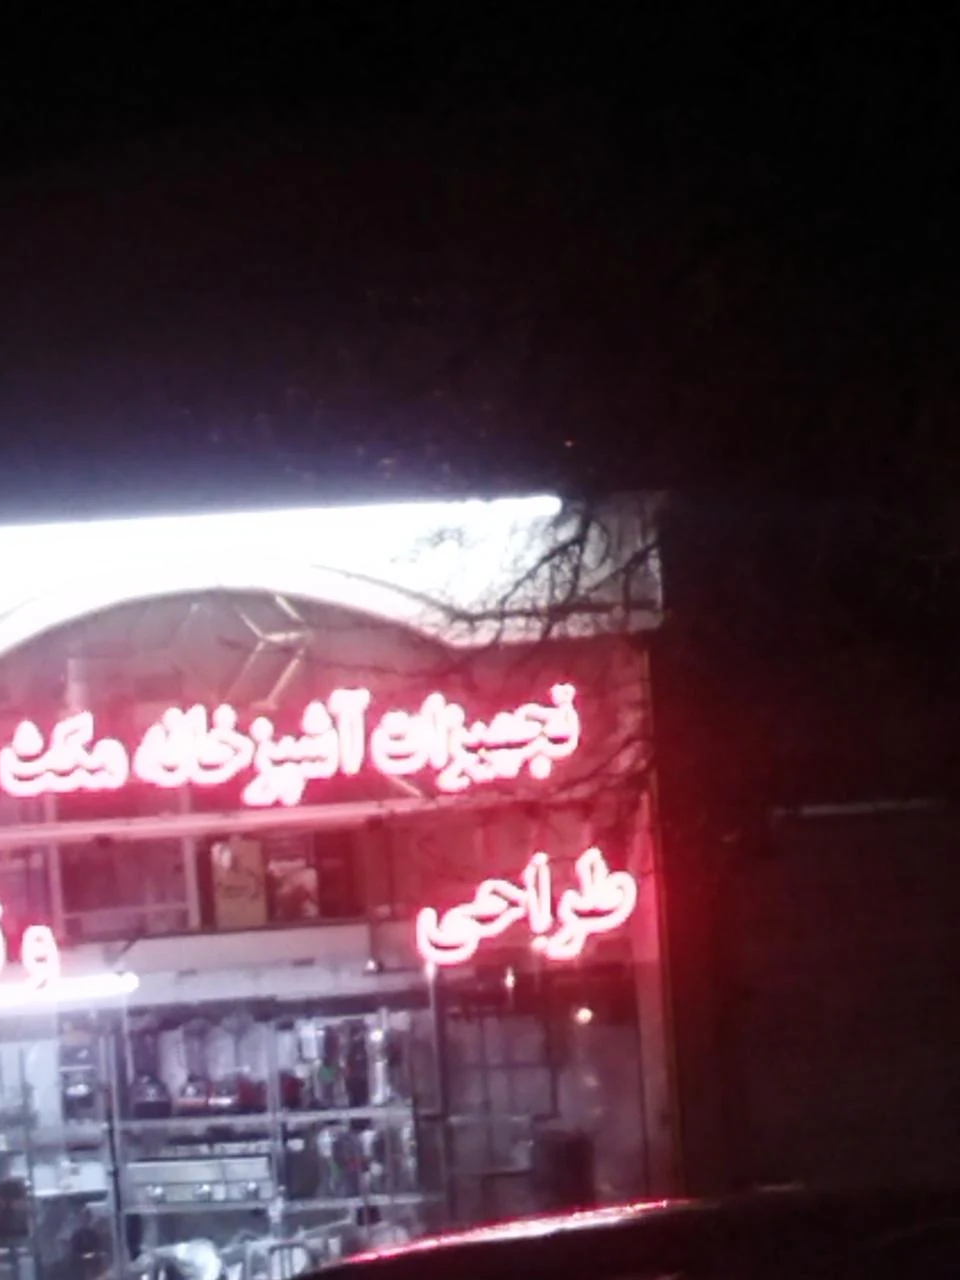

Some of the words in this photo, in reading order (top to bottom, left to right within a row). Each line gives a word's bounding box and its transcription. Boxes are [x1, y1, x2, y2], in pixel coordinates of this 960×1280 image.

[133, 687, 371, 807] آشپزخانه
[371, 682, 581, 792] تجهیزات
[14, 924, 61, 998] و
[416, 846, 638, 965] طراحی
